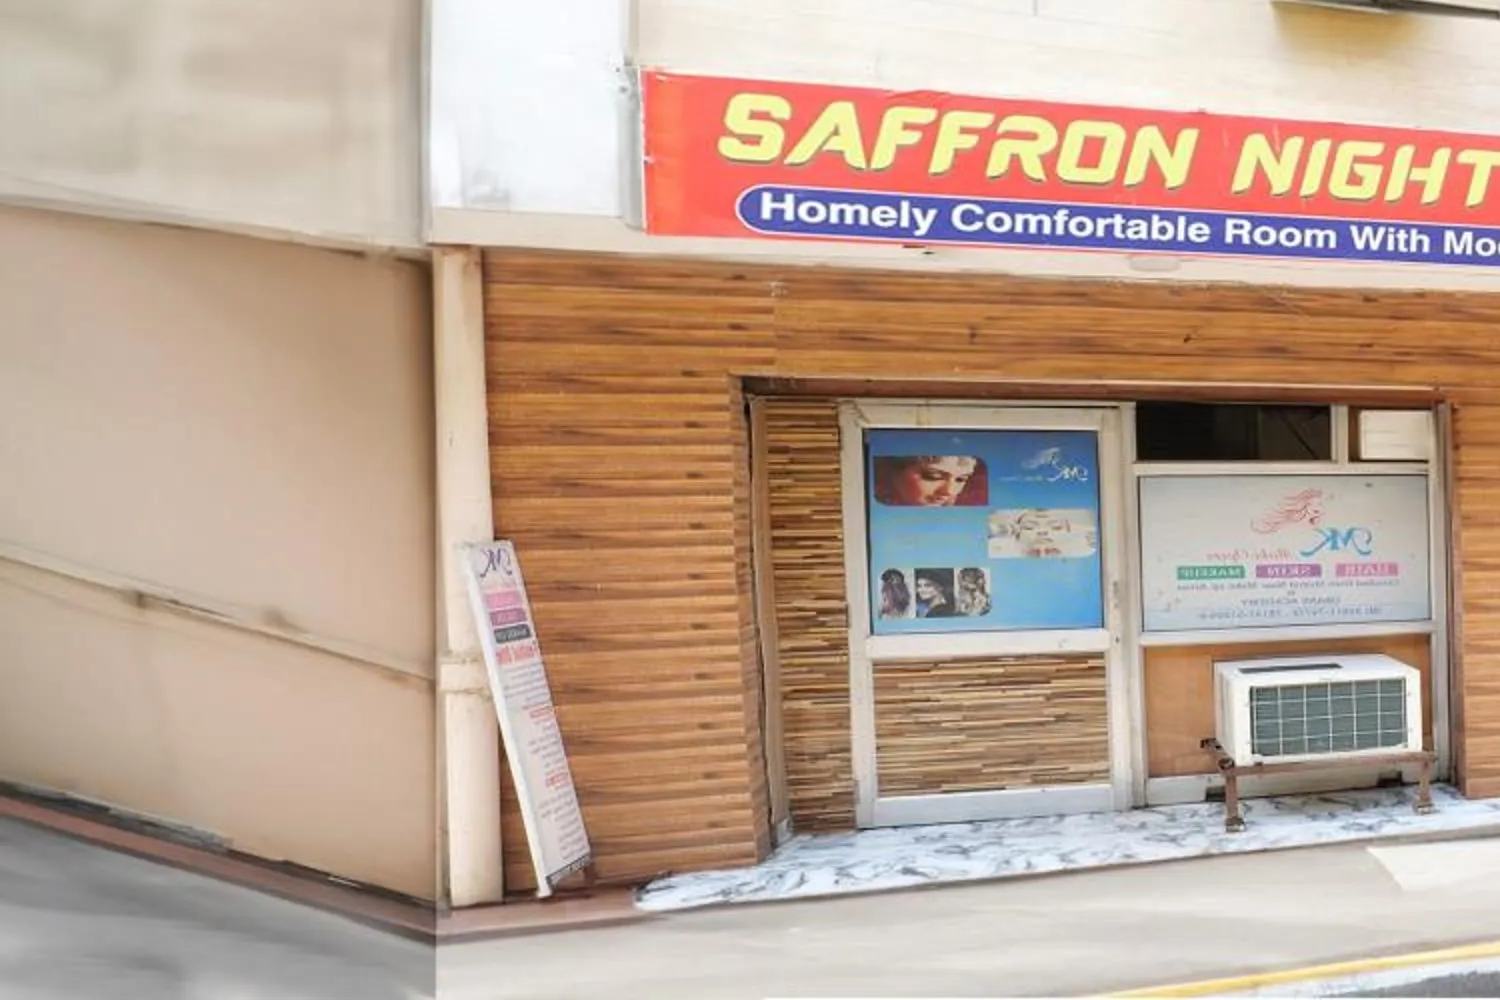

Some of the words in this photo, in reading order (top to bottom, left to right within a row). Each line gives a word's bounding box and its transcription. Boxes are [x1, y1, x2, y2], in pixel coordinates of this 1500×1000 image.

[718, 93, 1199, 189] SAFFRON
[760, 191, 938, 236] Homely
[952, 202, 1211, 244] Comfortable
[1225, 218, 1337, 249] Room
[1350, 225, 1430, 253] With
